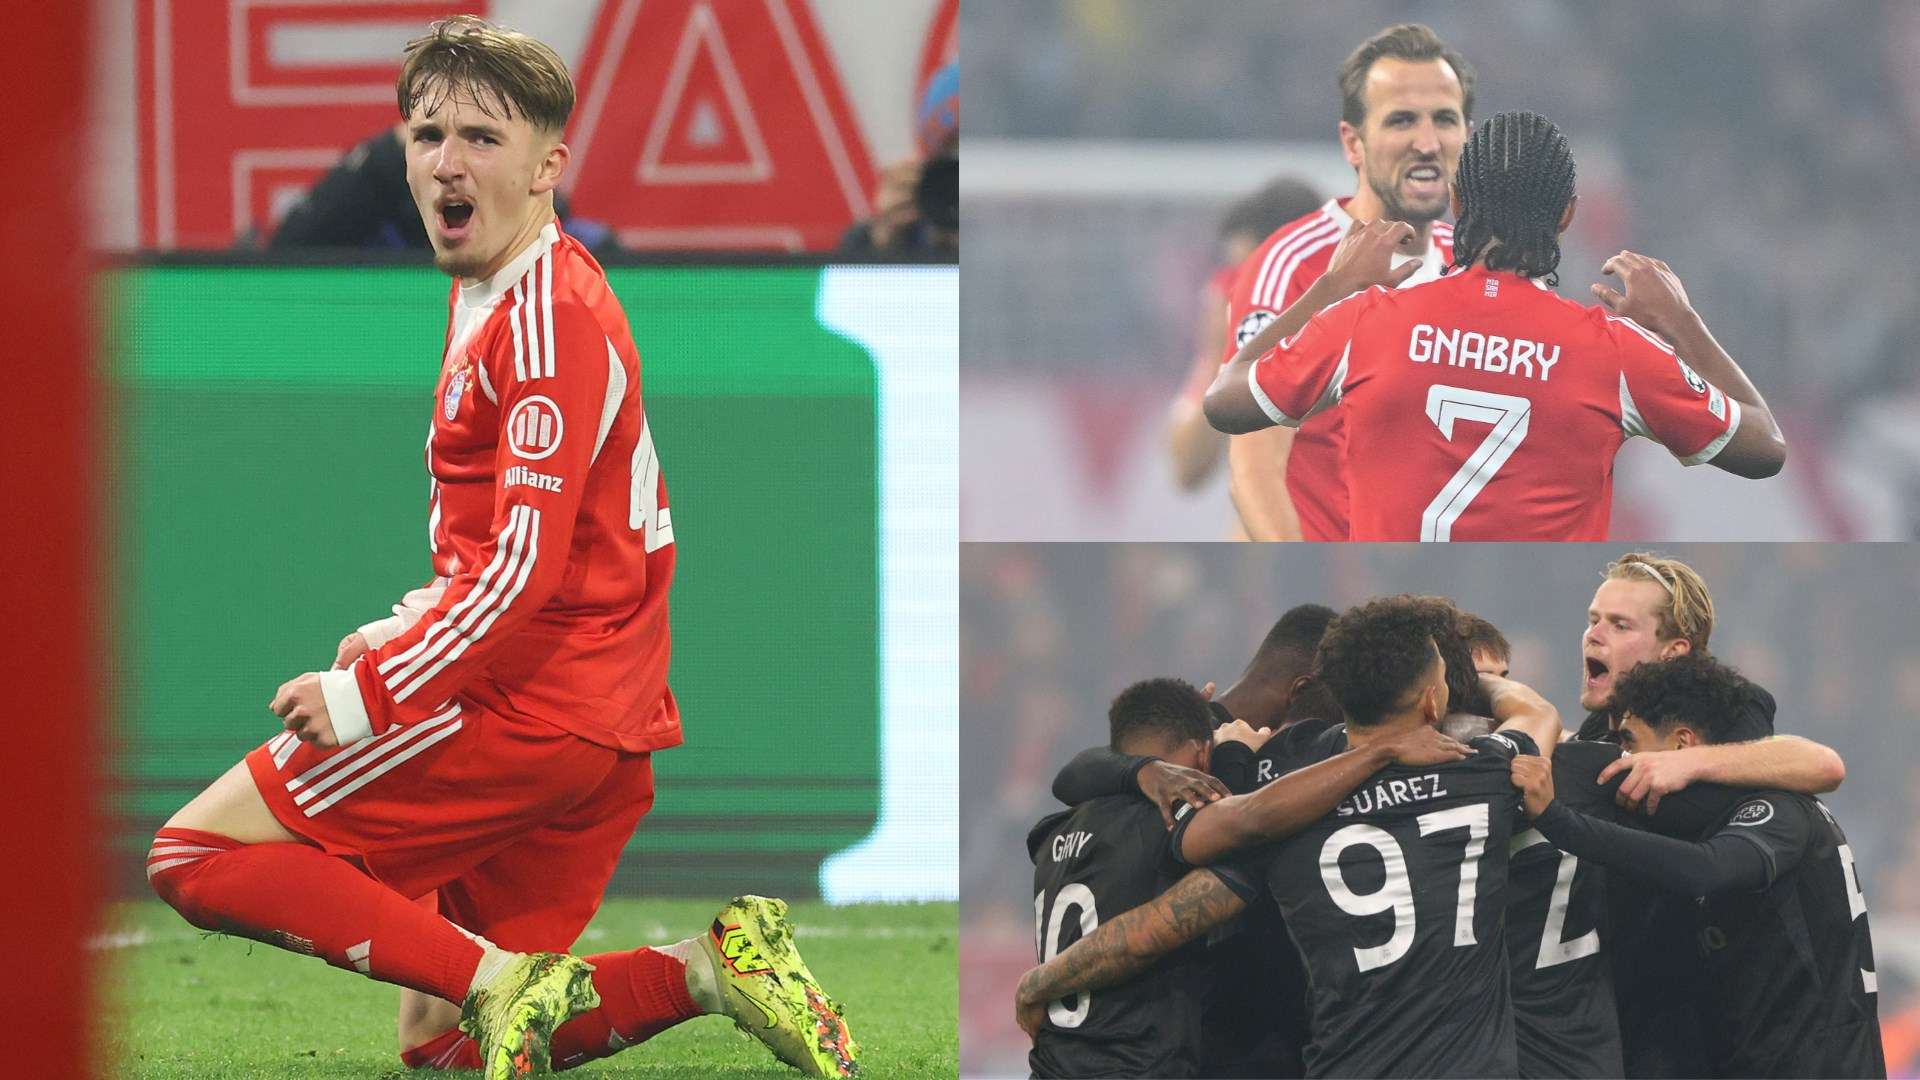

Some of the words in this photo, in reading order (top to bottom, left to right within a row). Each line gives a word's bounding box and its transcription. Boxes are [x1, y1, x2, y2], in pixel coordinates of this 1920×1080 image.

[1408, 324, 1560, 381] GNABRY
[504, 466, 564, 493] Allianz
[1420, 384, 1531, 542] 7
[1336, 773, 1448, 817] SUÁREZ
[1318, 803, 1490, 973] 97
